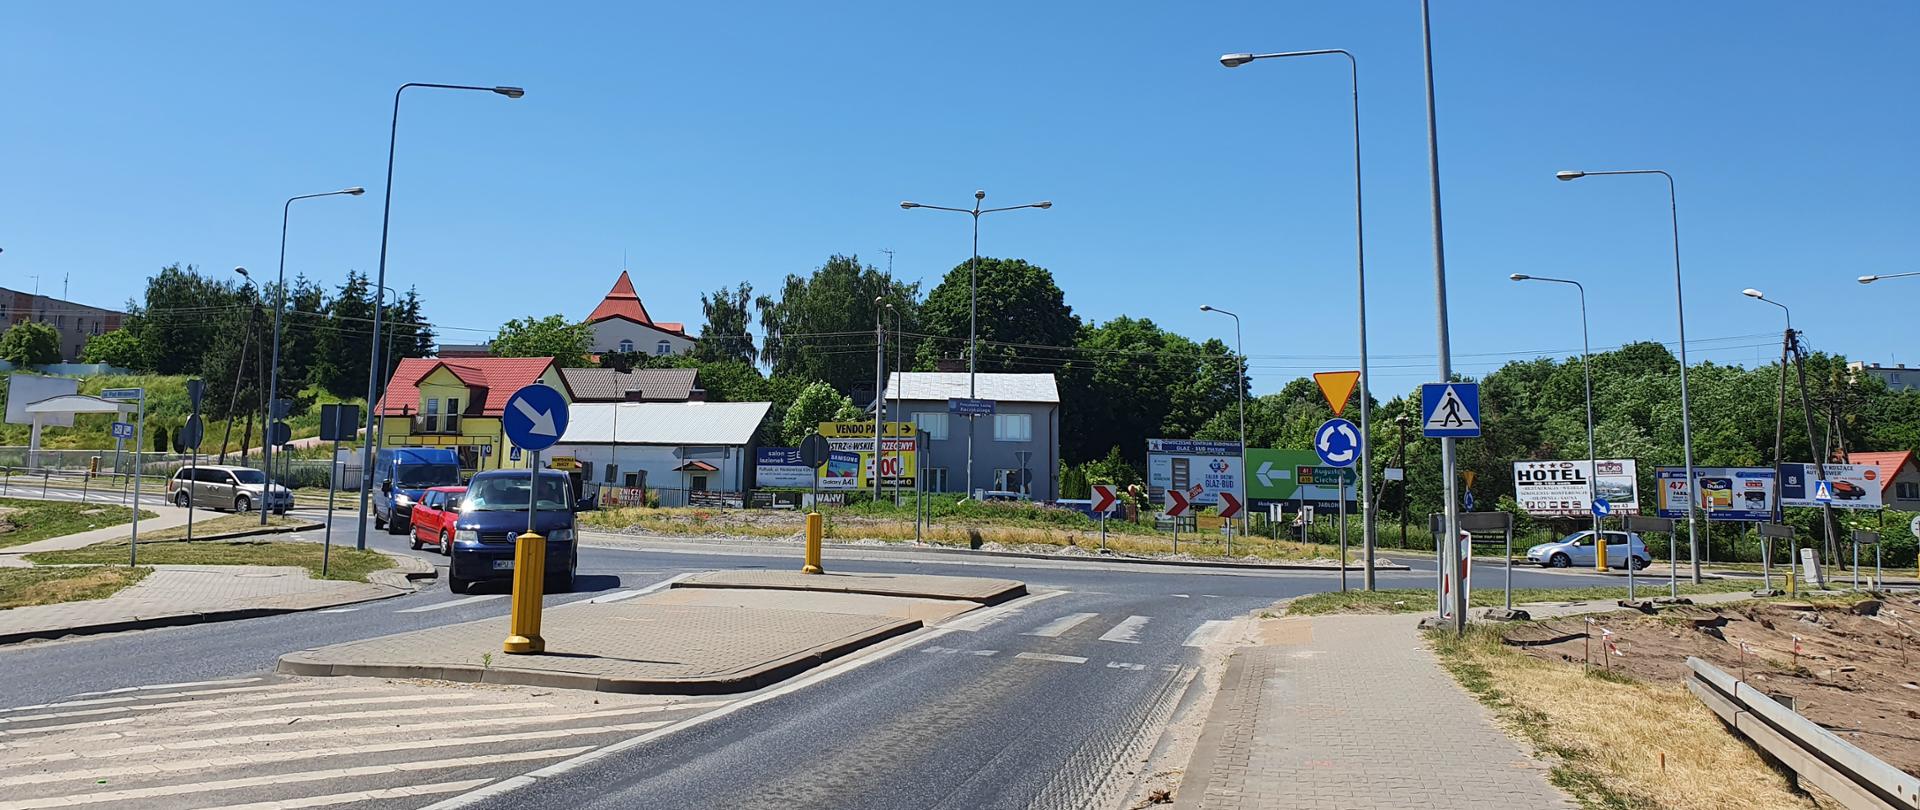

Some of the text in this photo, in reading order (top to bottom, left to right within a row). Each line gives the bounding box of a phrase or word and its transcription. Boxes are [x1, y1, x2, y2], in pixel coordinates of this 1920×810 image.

[836, 424, 888, 433] VENDO PAK
[881, 441, 913, 450] RZECENY!
[830, 454, 858, 462] SAMSUNG
[1517, 469, 1587, 481] HOTEL
[1205, 479, 1234, 488] GLAZ-BUD
